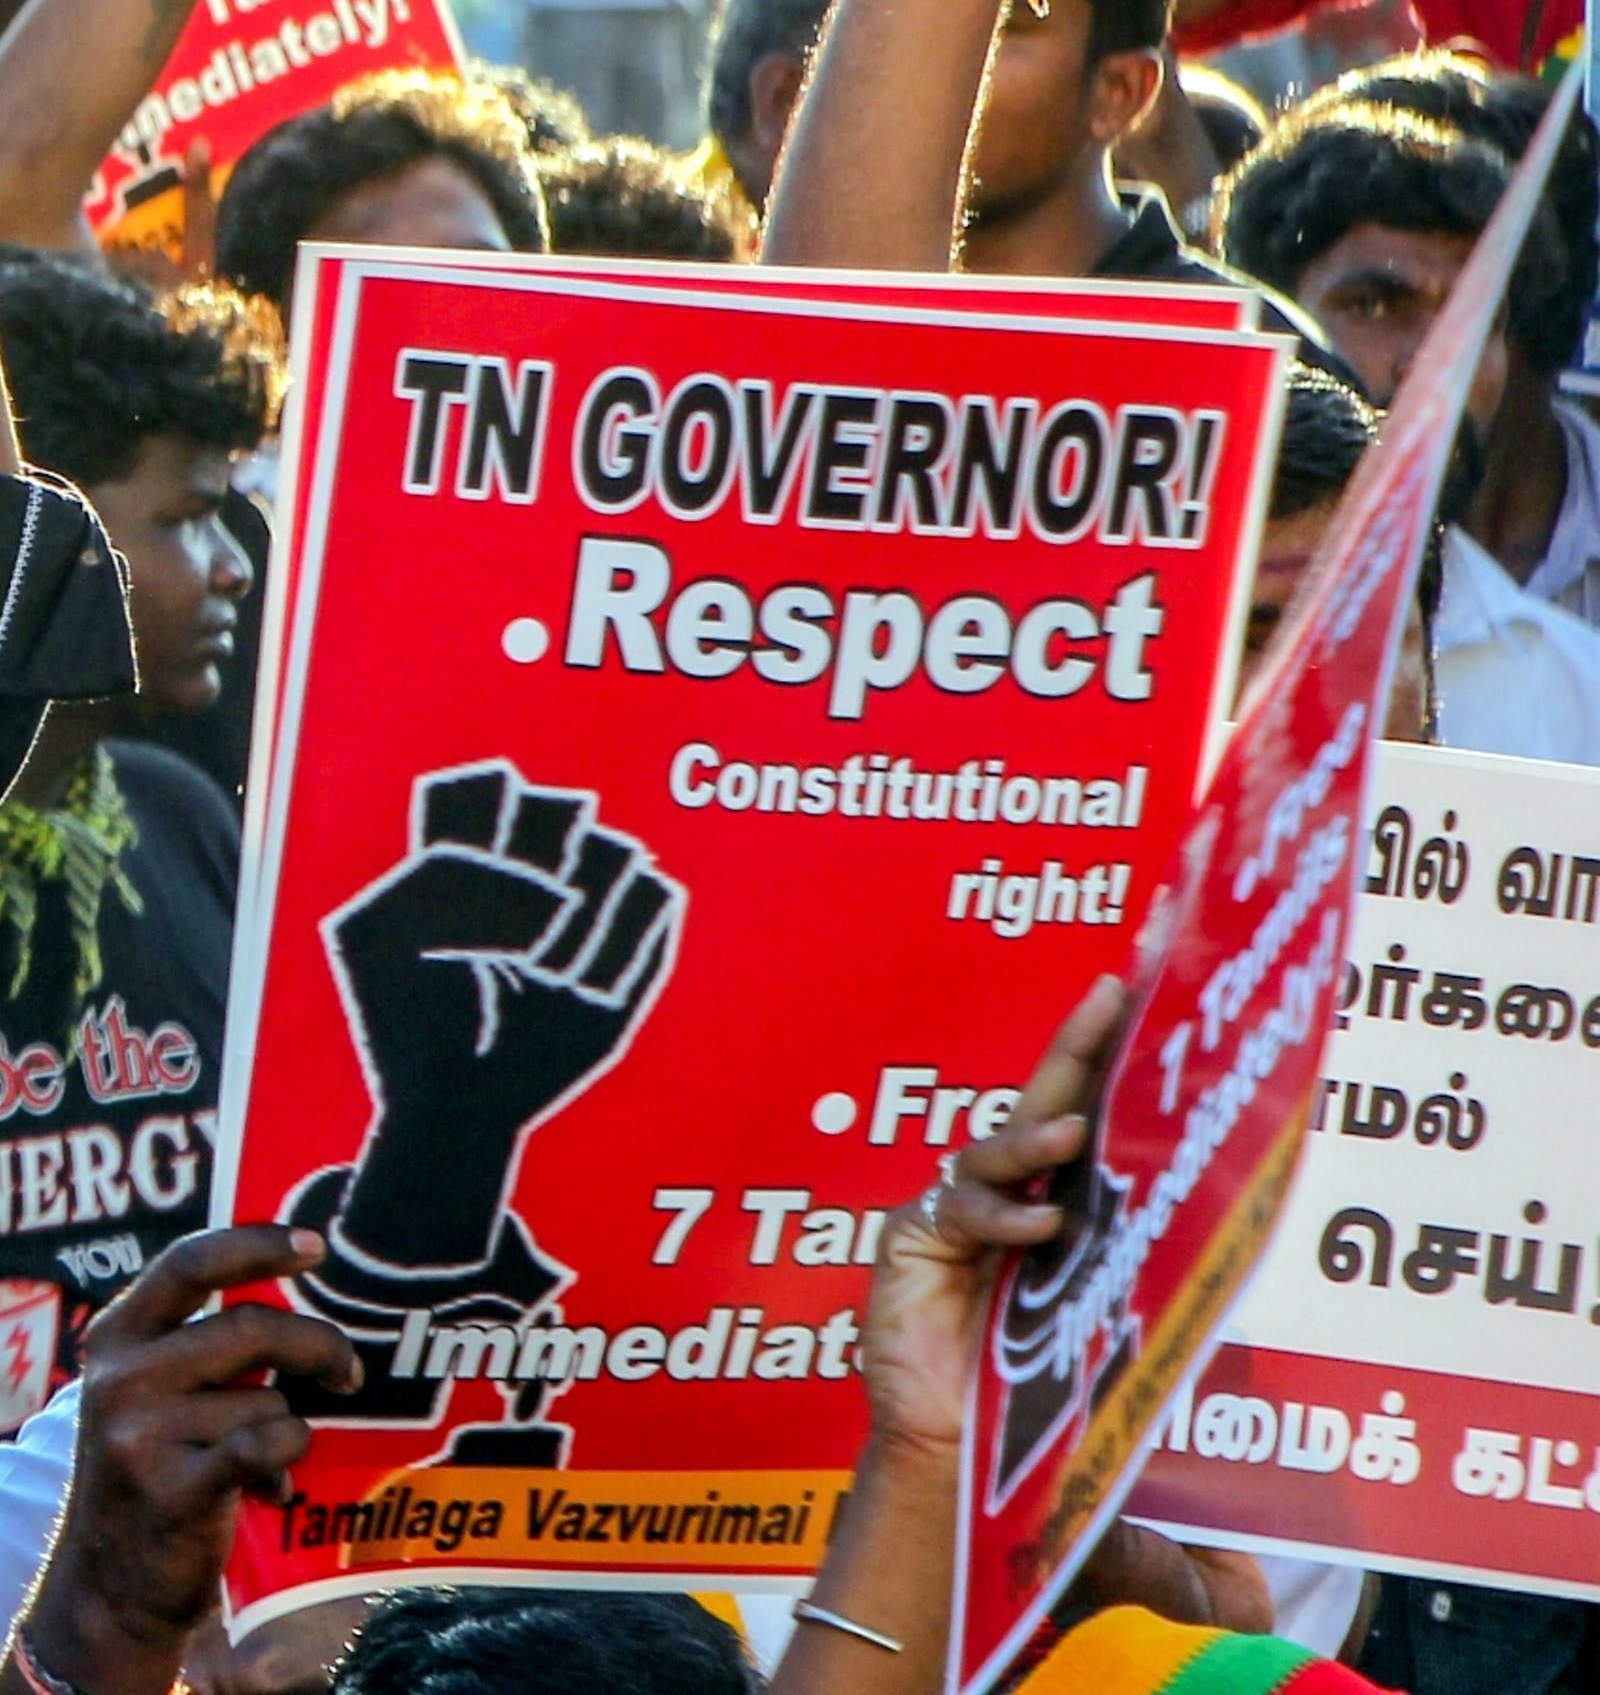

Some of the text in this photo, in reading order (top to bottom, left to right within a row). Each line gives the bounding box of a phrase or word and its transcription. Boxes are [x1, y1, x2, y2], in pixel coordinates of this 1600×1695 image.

[396, 347, 1227, 550] TN GOVERNOR!
[668, 739, 1147, 830] Constitutional
[947, 859, 1132, 940] right!
[76, 995, 201, 1103] the
[867, 1064, 1022, 1146] Fre
[651, 1187, 715, 1266] 7
[393, 1306, 862, 1382] Immediat
[278, 1486, 502, 1553] Tamilaga
[527, 1488, 814, 1546] Vazvurimai
